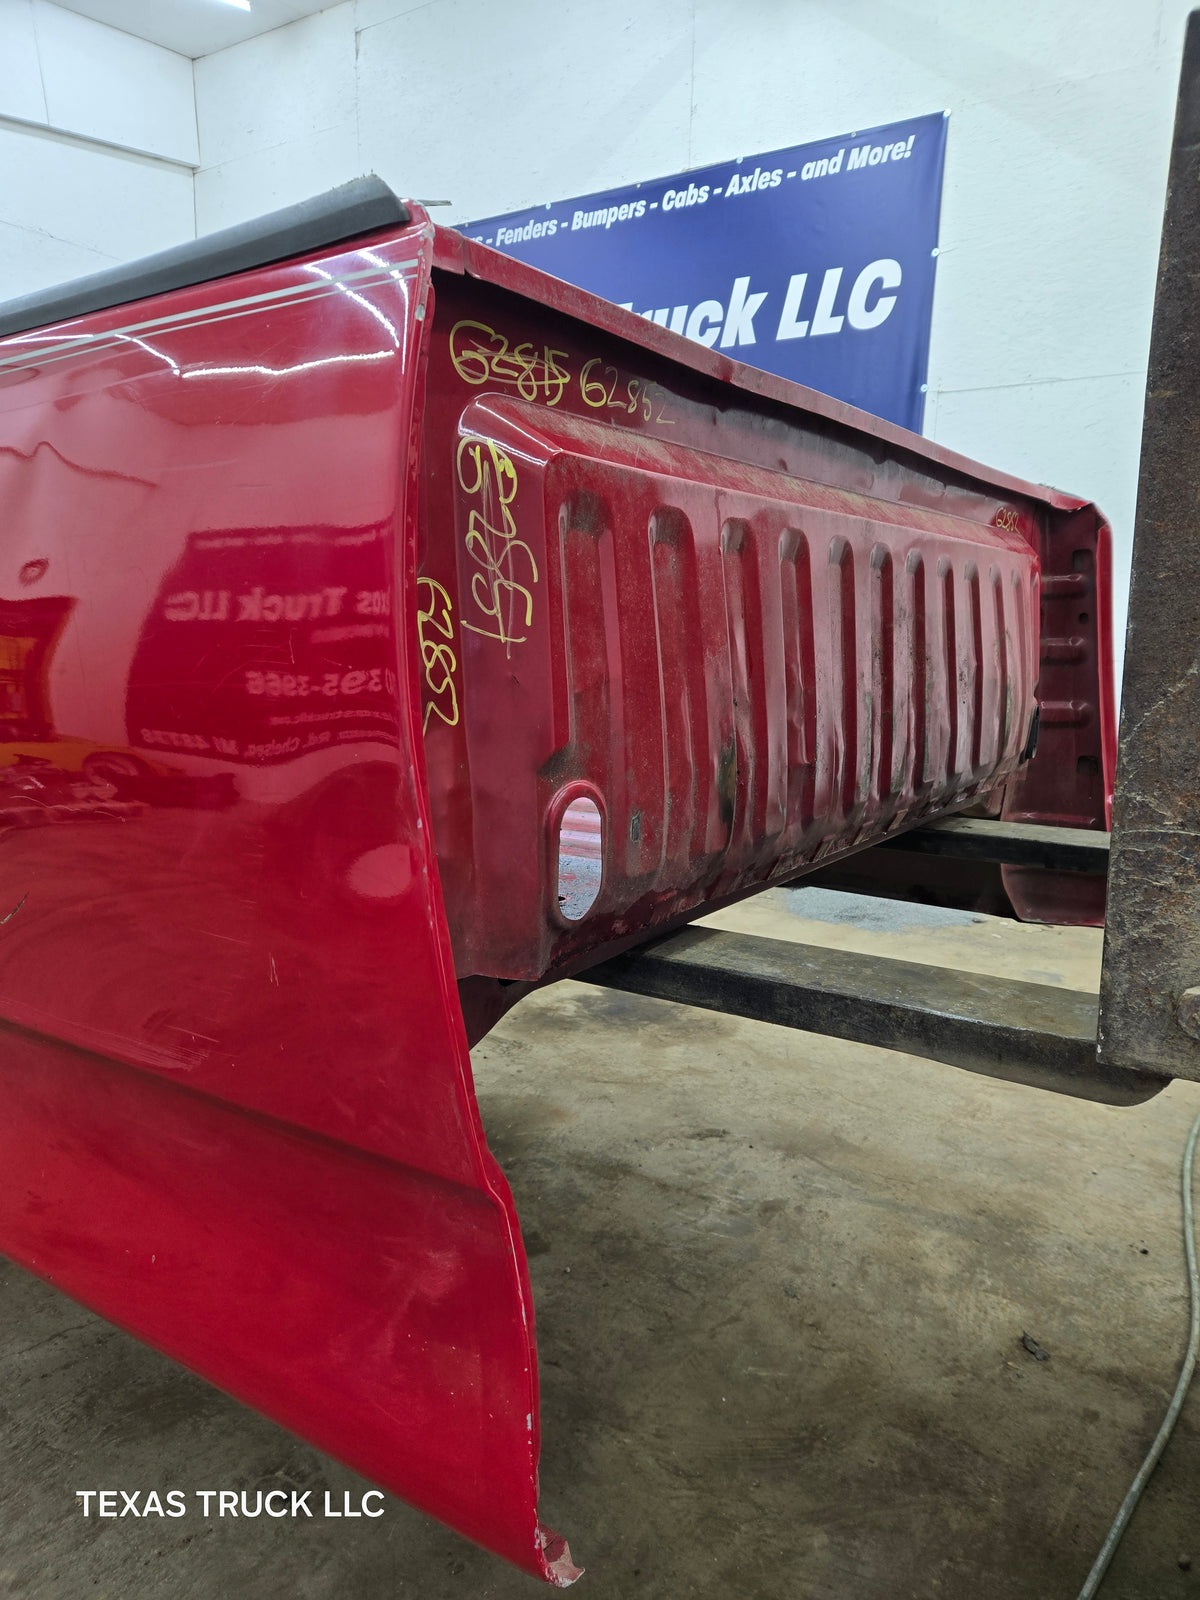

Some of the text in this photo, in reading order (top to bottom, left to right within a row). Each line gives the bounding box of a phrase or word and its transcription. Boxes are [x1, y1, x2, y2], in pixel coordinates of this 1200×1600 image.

[495, 219, 558, 247] Fenders
[571, 200, 647, 230] Bumpers
[661, 183, 710, 212] Cabs
[725, 168, 783, 197] Axles
[801, 149, 846, 181] and
[847, 135, 916, 170] More!
[775, 258, 903, 341] LLC
[579, 358, 675, 424] 62852
